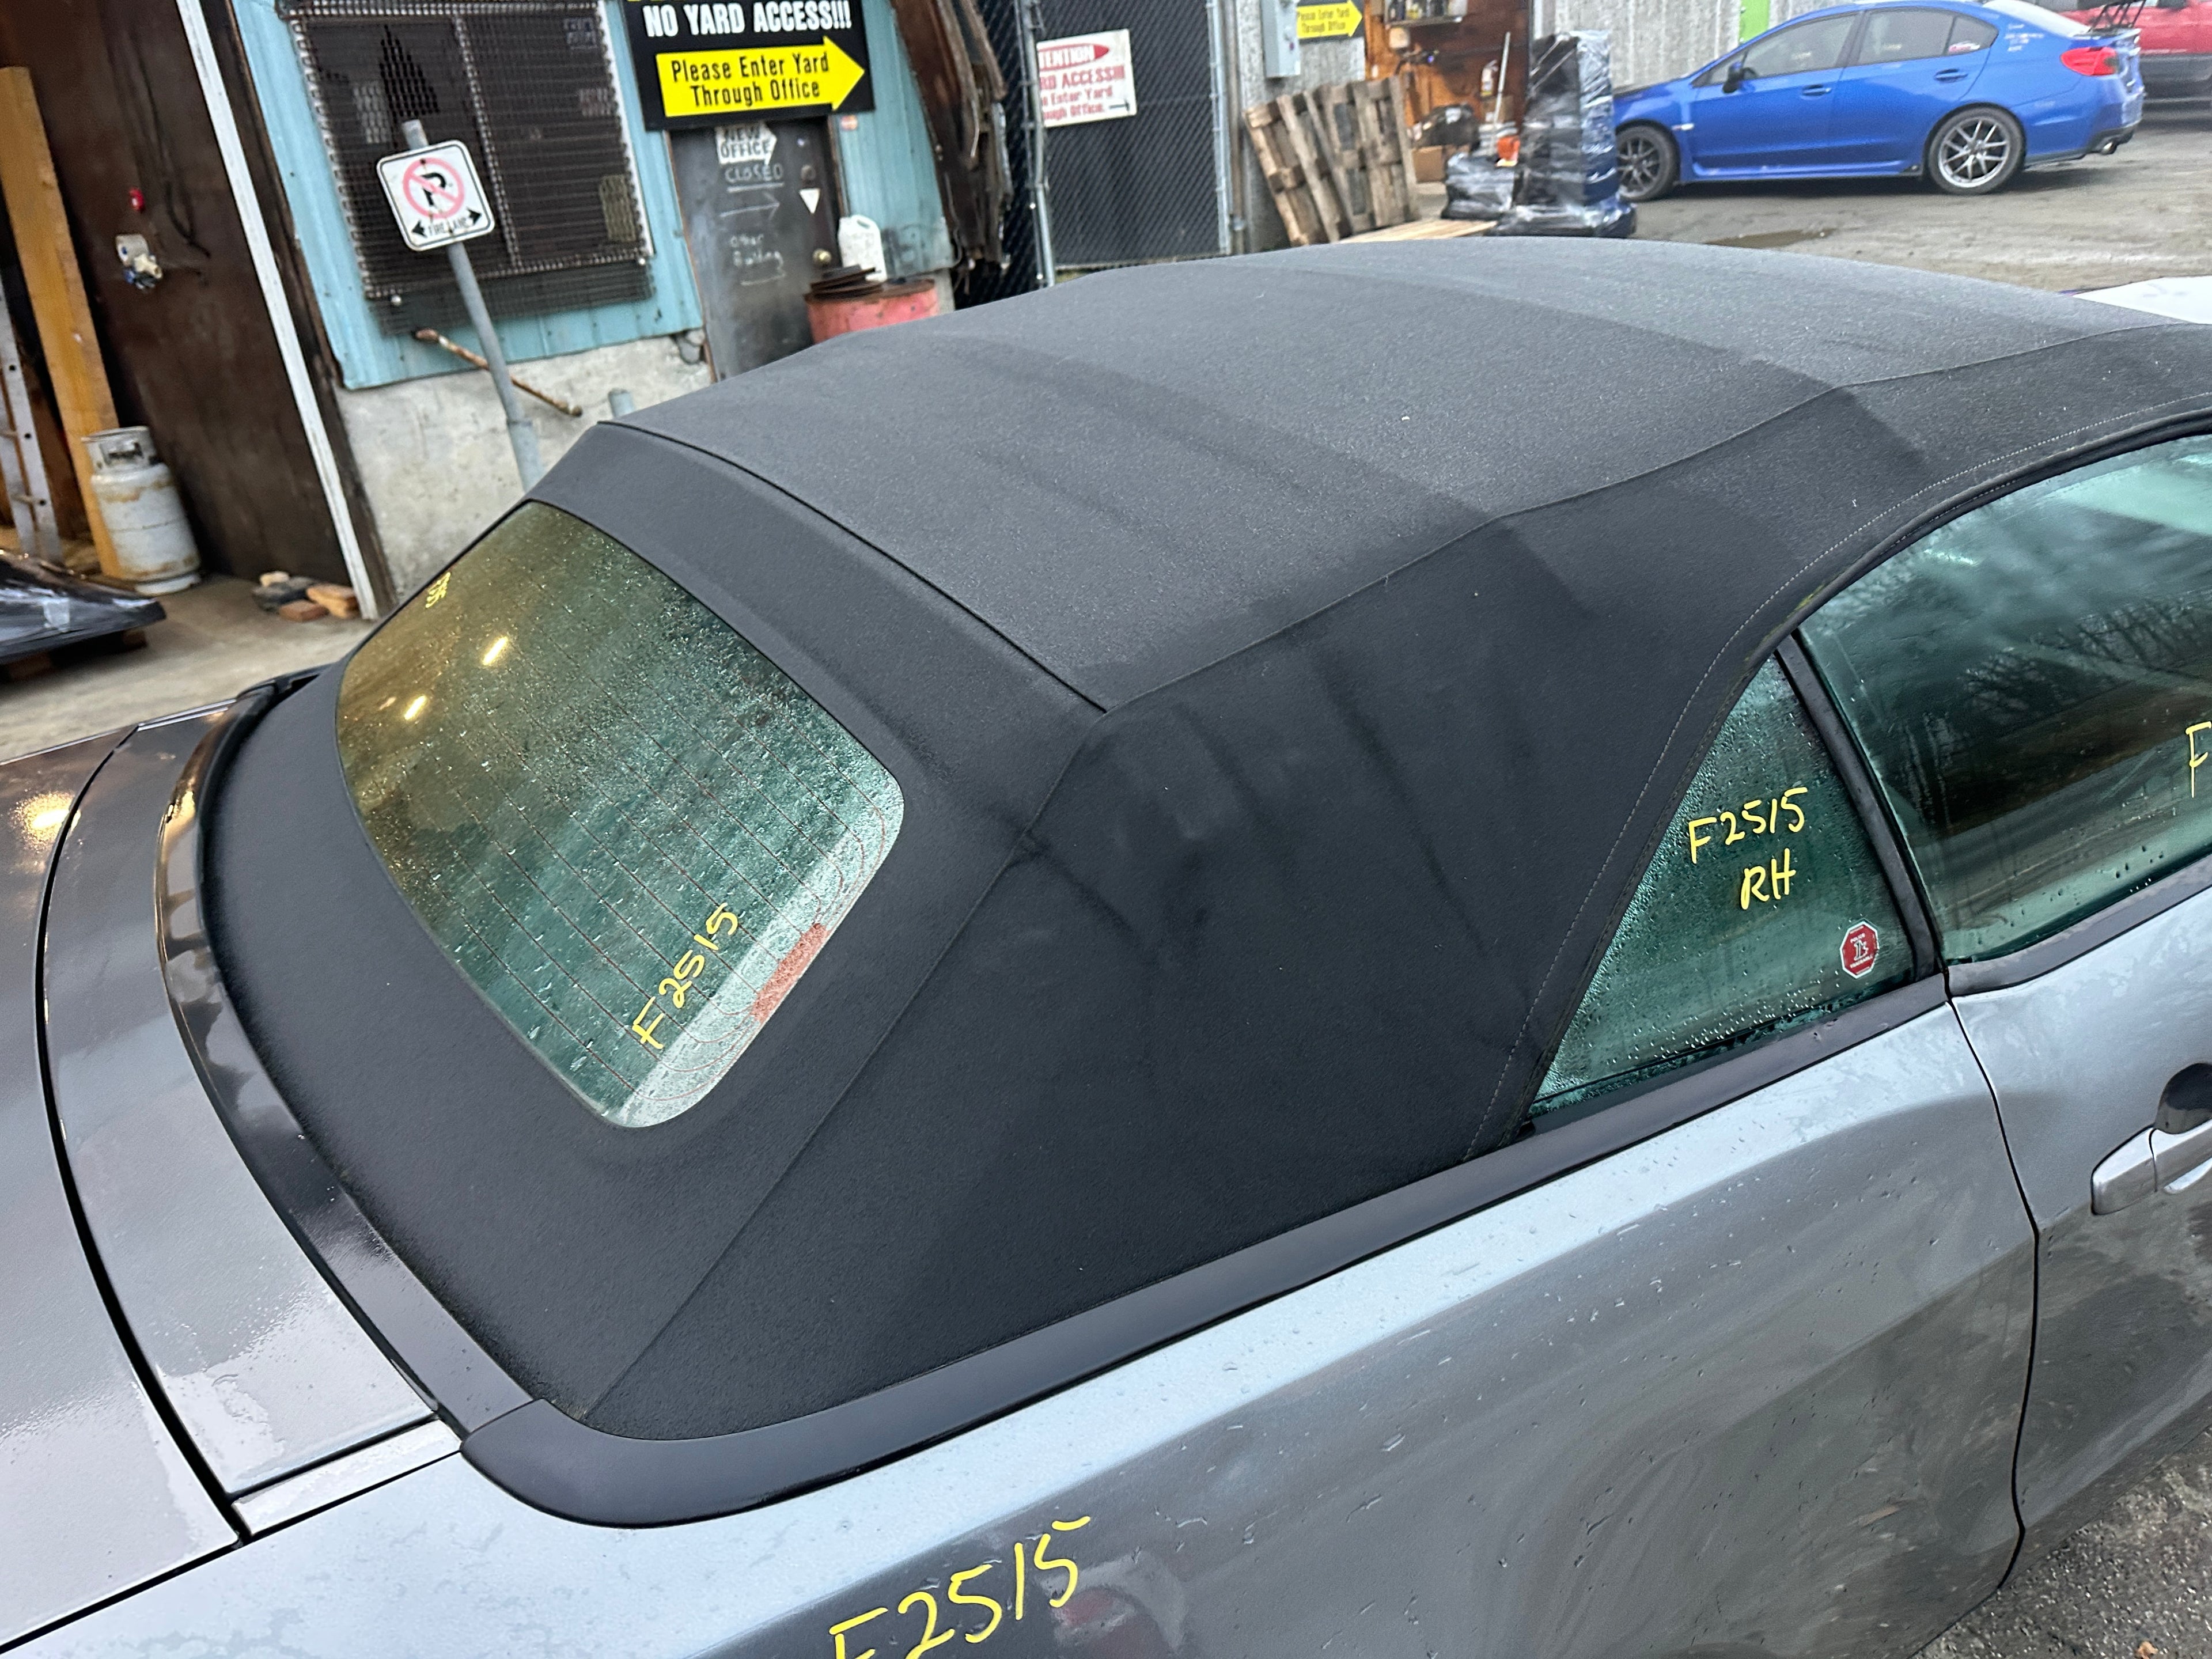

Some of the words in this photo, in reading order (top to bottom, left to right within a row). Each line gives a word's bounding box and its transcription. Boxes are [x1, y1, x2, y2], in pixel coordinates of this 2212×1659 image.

[642, 4, 679, 37] NO
[683, 2, 746, 36] YARD
[753, 0, 852, 33] ACCESS!!!
[671, 59, 732, 83] Please
[739, 56, 785, 79] Enter
[792, 52, 830, 74] Yard
[690, 82, 763, 108] Through
[771, 79, 821, 101] Office
[1051, 91, 1082, 105] Enter
[1085, 85, 1113, 100] Yard
[721, 139, 771, 158] OFFICE
[725, 162, 784, 183] CLOSED
[1688, 786, 1808, 865] F2515
[1740, 848, 1797, 910] RH
[631, 903, 738, 1050] F2515
[829, 1516, 1091, 1659] F2515
